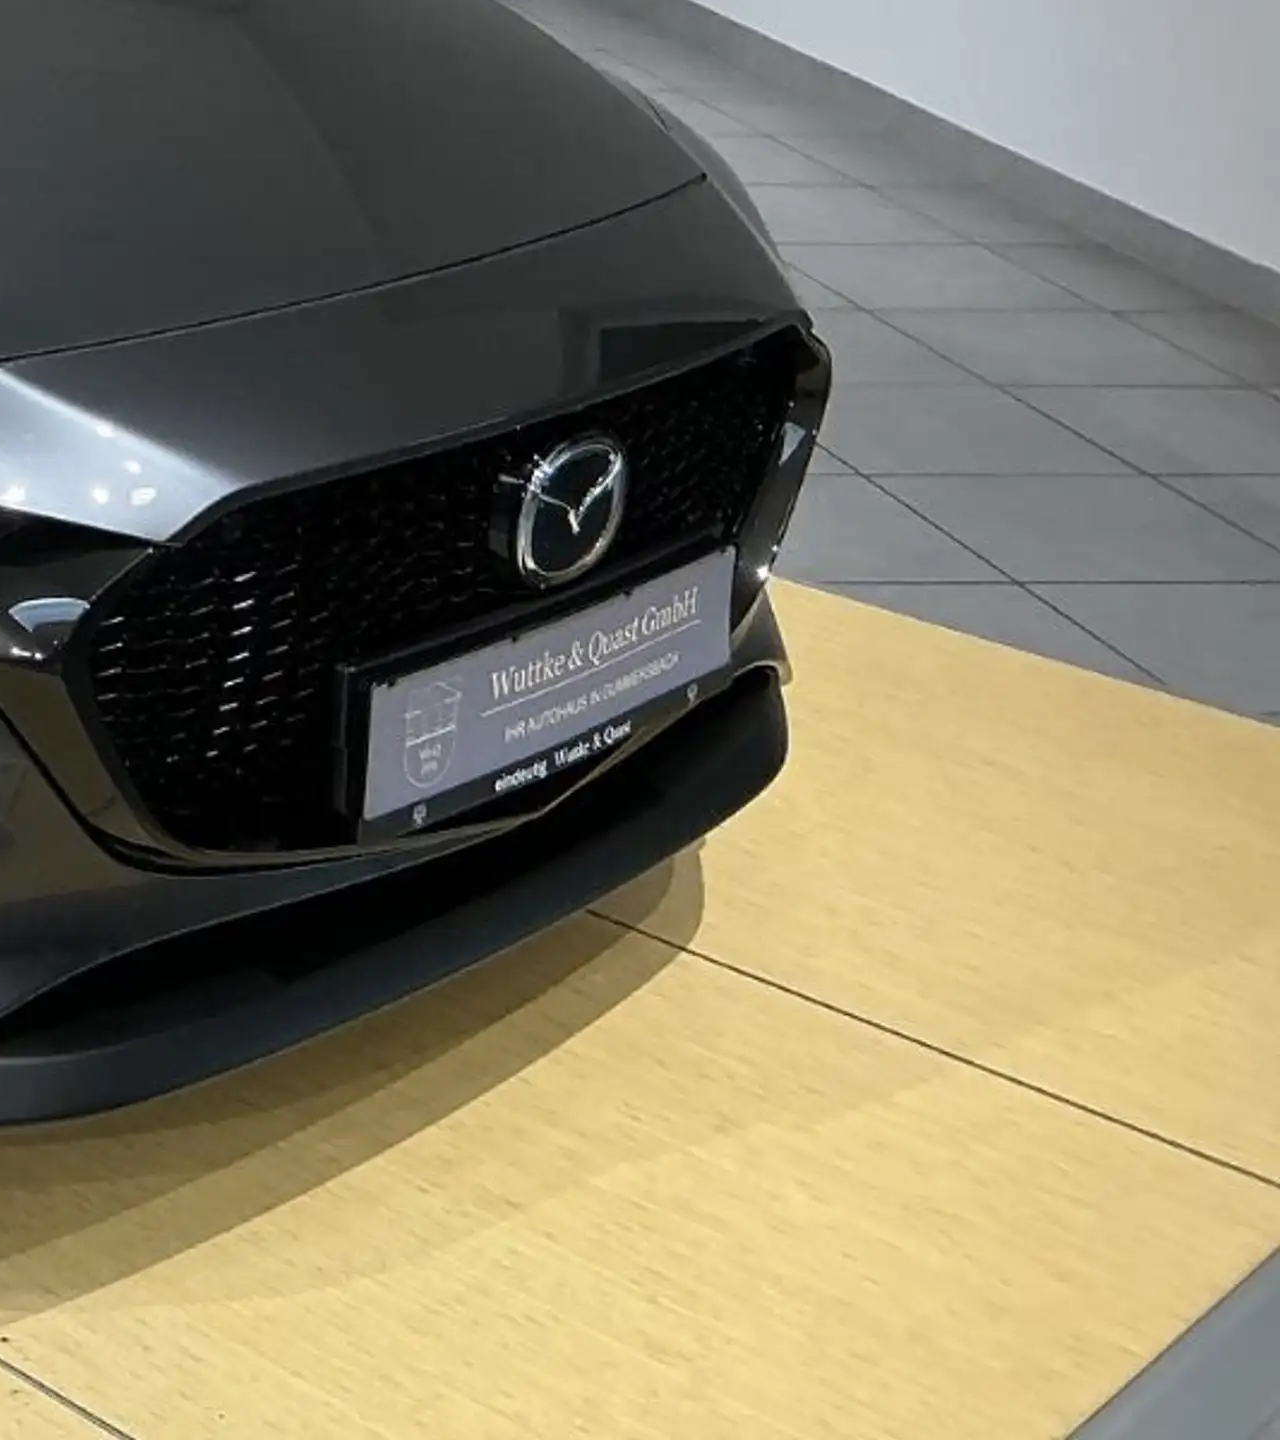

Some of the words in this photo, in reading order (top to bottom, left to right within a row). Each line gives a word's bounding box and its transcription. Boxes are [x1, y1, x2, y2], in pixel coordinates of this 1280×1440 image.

[492, 649, 564, 700] Wuttke
[568, 640, 585, 670] &
[588, 616, 639, 666] Quast
[641, 586, 699, 636] GmbH
